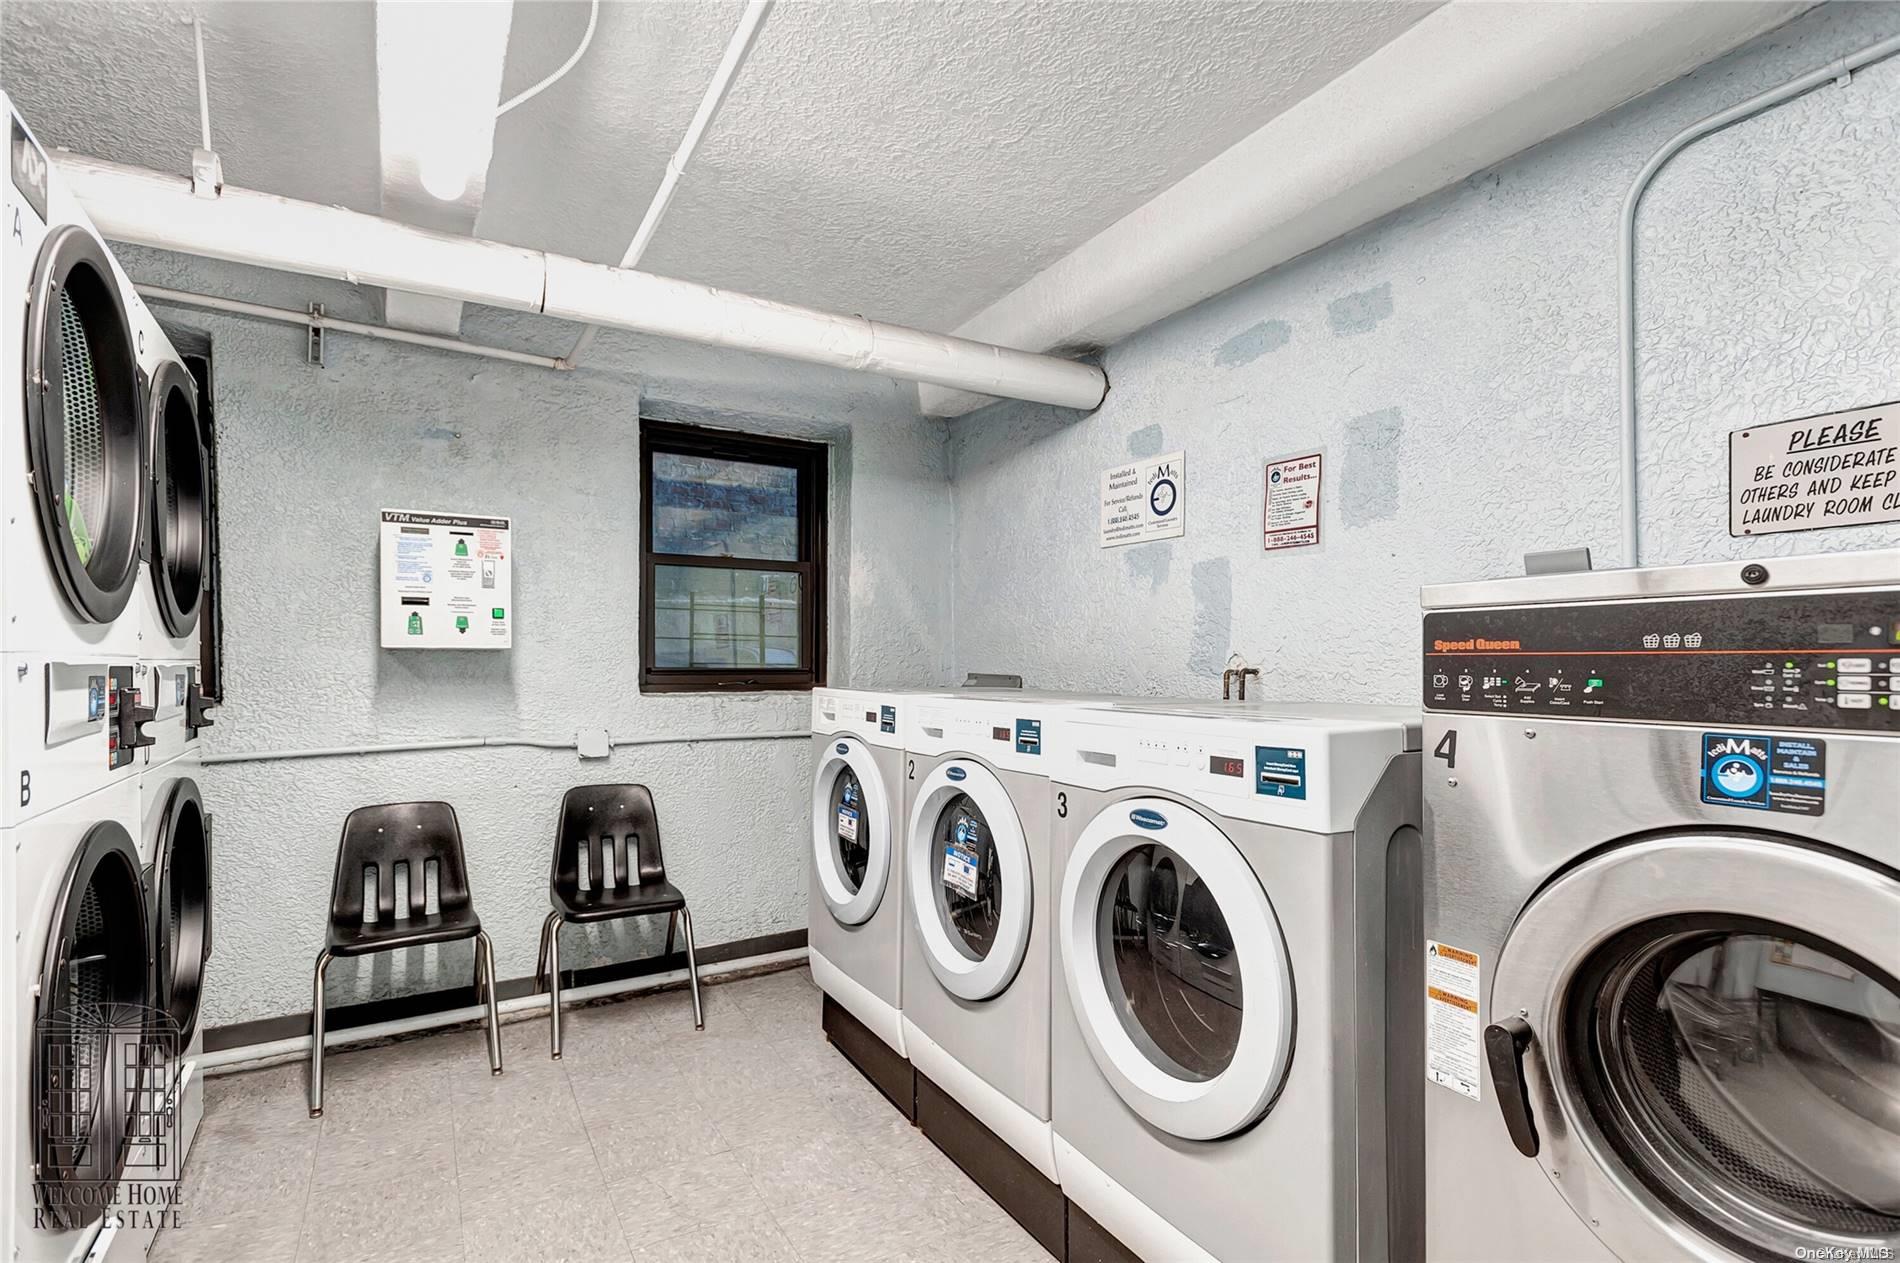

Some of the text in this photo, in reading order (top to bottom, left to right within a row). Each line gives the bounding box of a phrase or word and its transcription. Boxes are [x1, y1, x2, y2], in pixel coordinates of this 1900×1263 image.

[13, 207, 23, 246] A
[1788, 418, 1883, 451] PLEASE
[1109, 468, 1132, 480] Installed
[1283, 461, 1317, 473] For Best
[1754, 447, 1898, 482] BE CONSIDERATE
[1108, 477, 1138, 491] Maintained
[1740, 470, 1897, 504] OTHERS AND KEEP
[384, 512, 410, 522] VTM
[431, 517, 451, 525] Adder
[1742, 502, 1815, 525] LAUNDRY
[1823, 496, 1874, 516] ROOM
[1433, 638, 1521, 652] Speed Queen
[1433, 729, 1457, 769] 4
[908, 760, 915, 780] 2
[20, 770, 31, 807] B
[1057, 792, 1068, 818] 3
[1443, 992, 1468, 1004] WARNING
